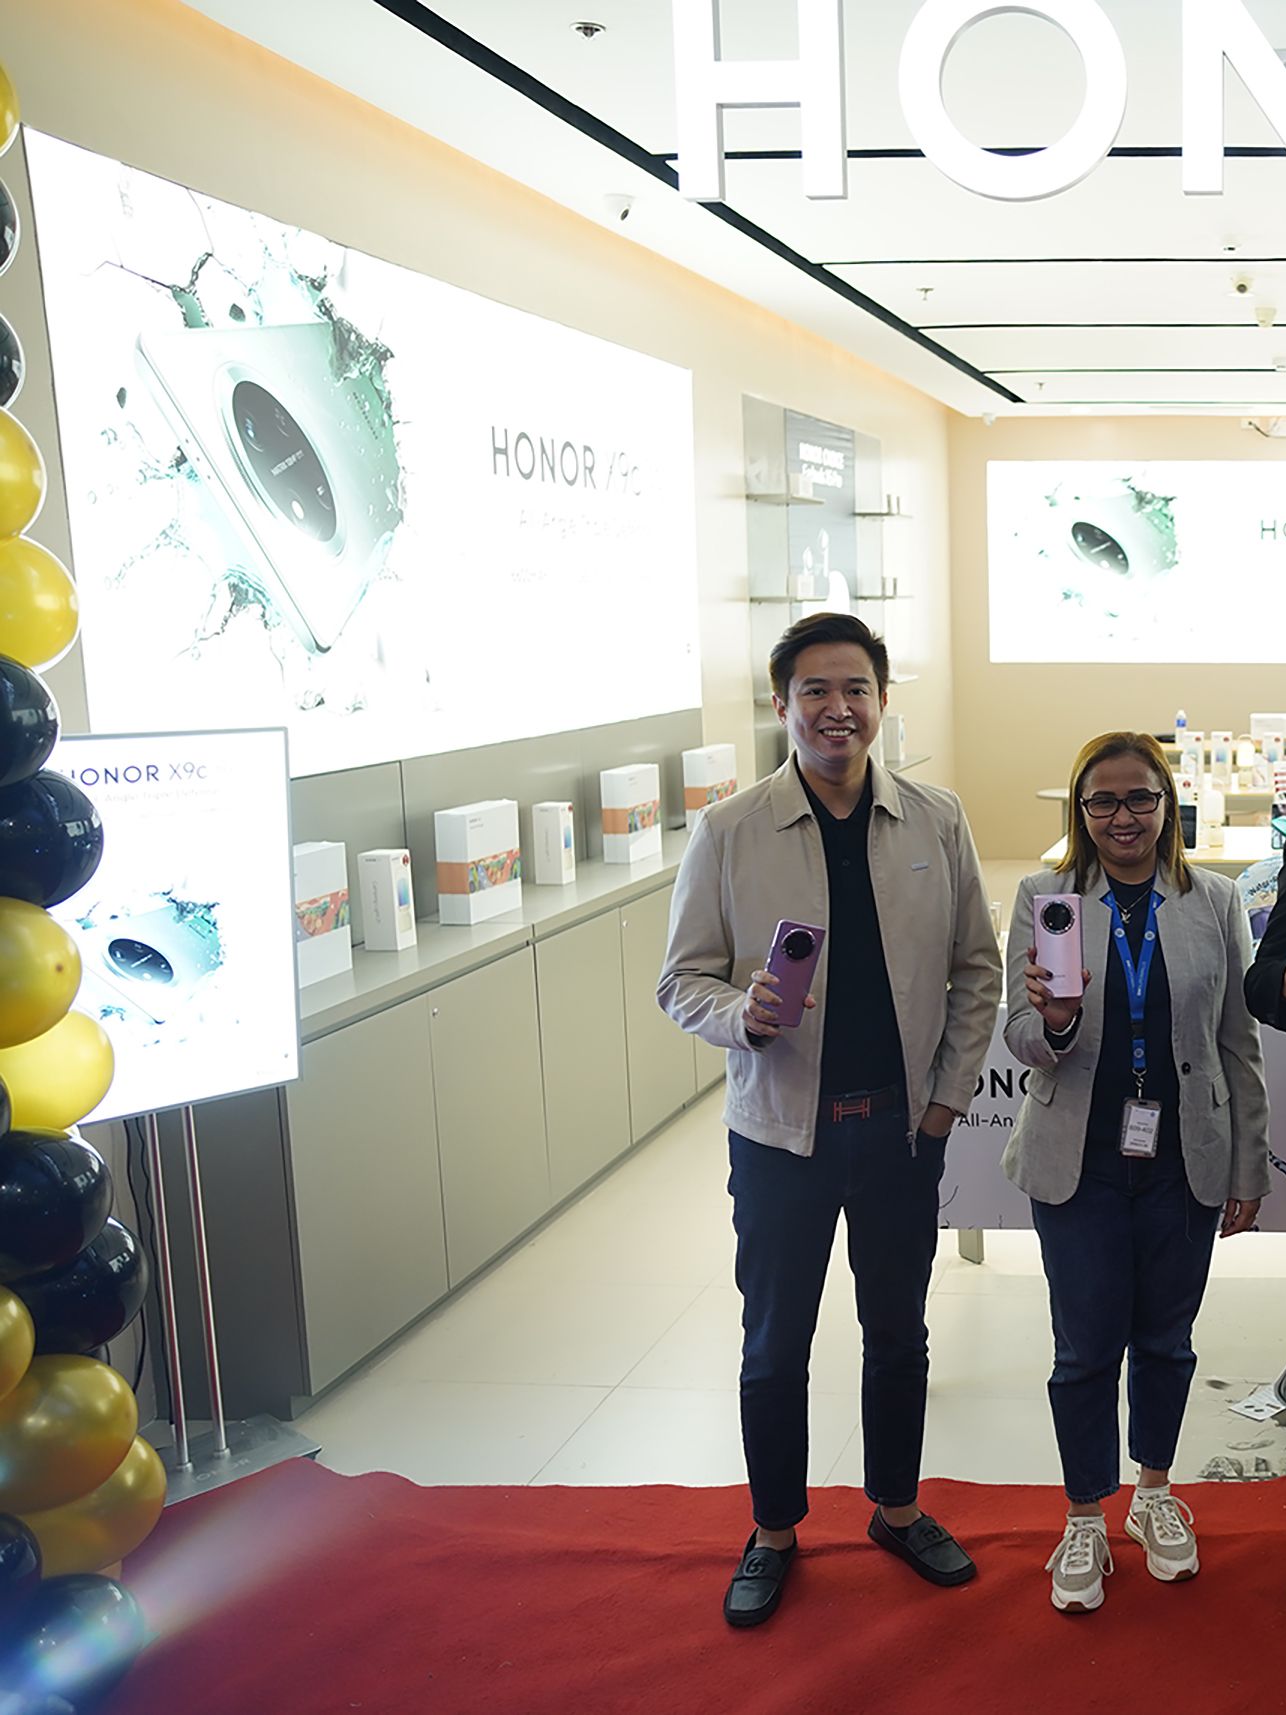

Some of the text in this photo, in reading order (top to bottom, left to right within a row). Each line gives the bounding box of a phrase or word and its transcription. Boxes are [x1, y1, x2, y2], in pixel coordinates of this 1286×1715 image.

[491, 425, 597, 490] HONOR
[60, 764, 160, 786] ONOR
[169, 761, 208, 781] X9c
